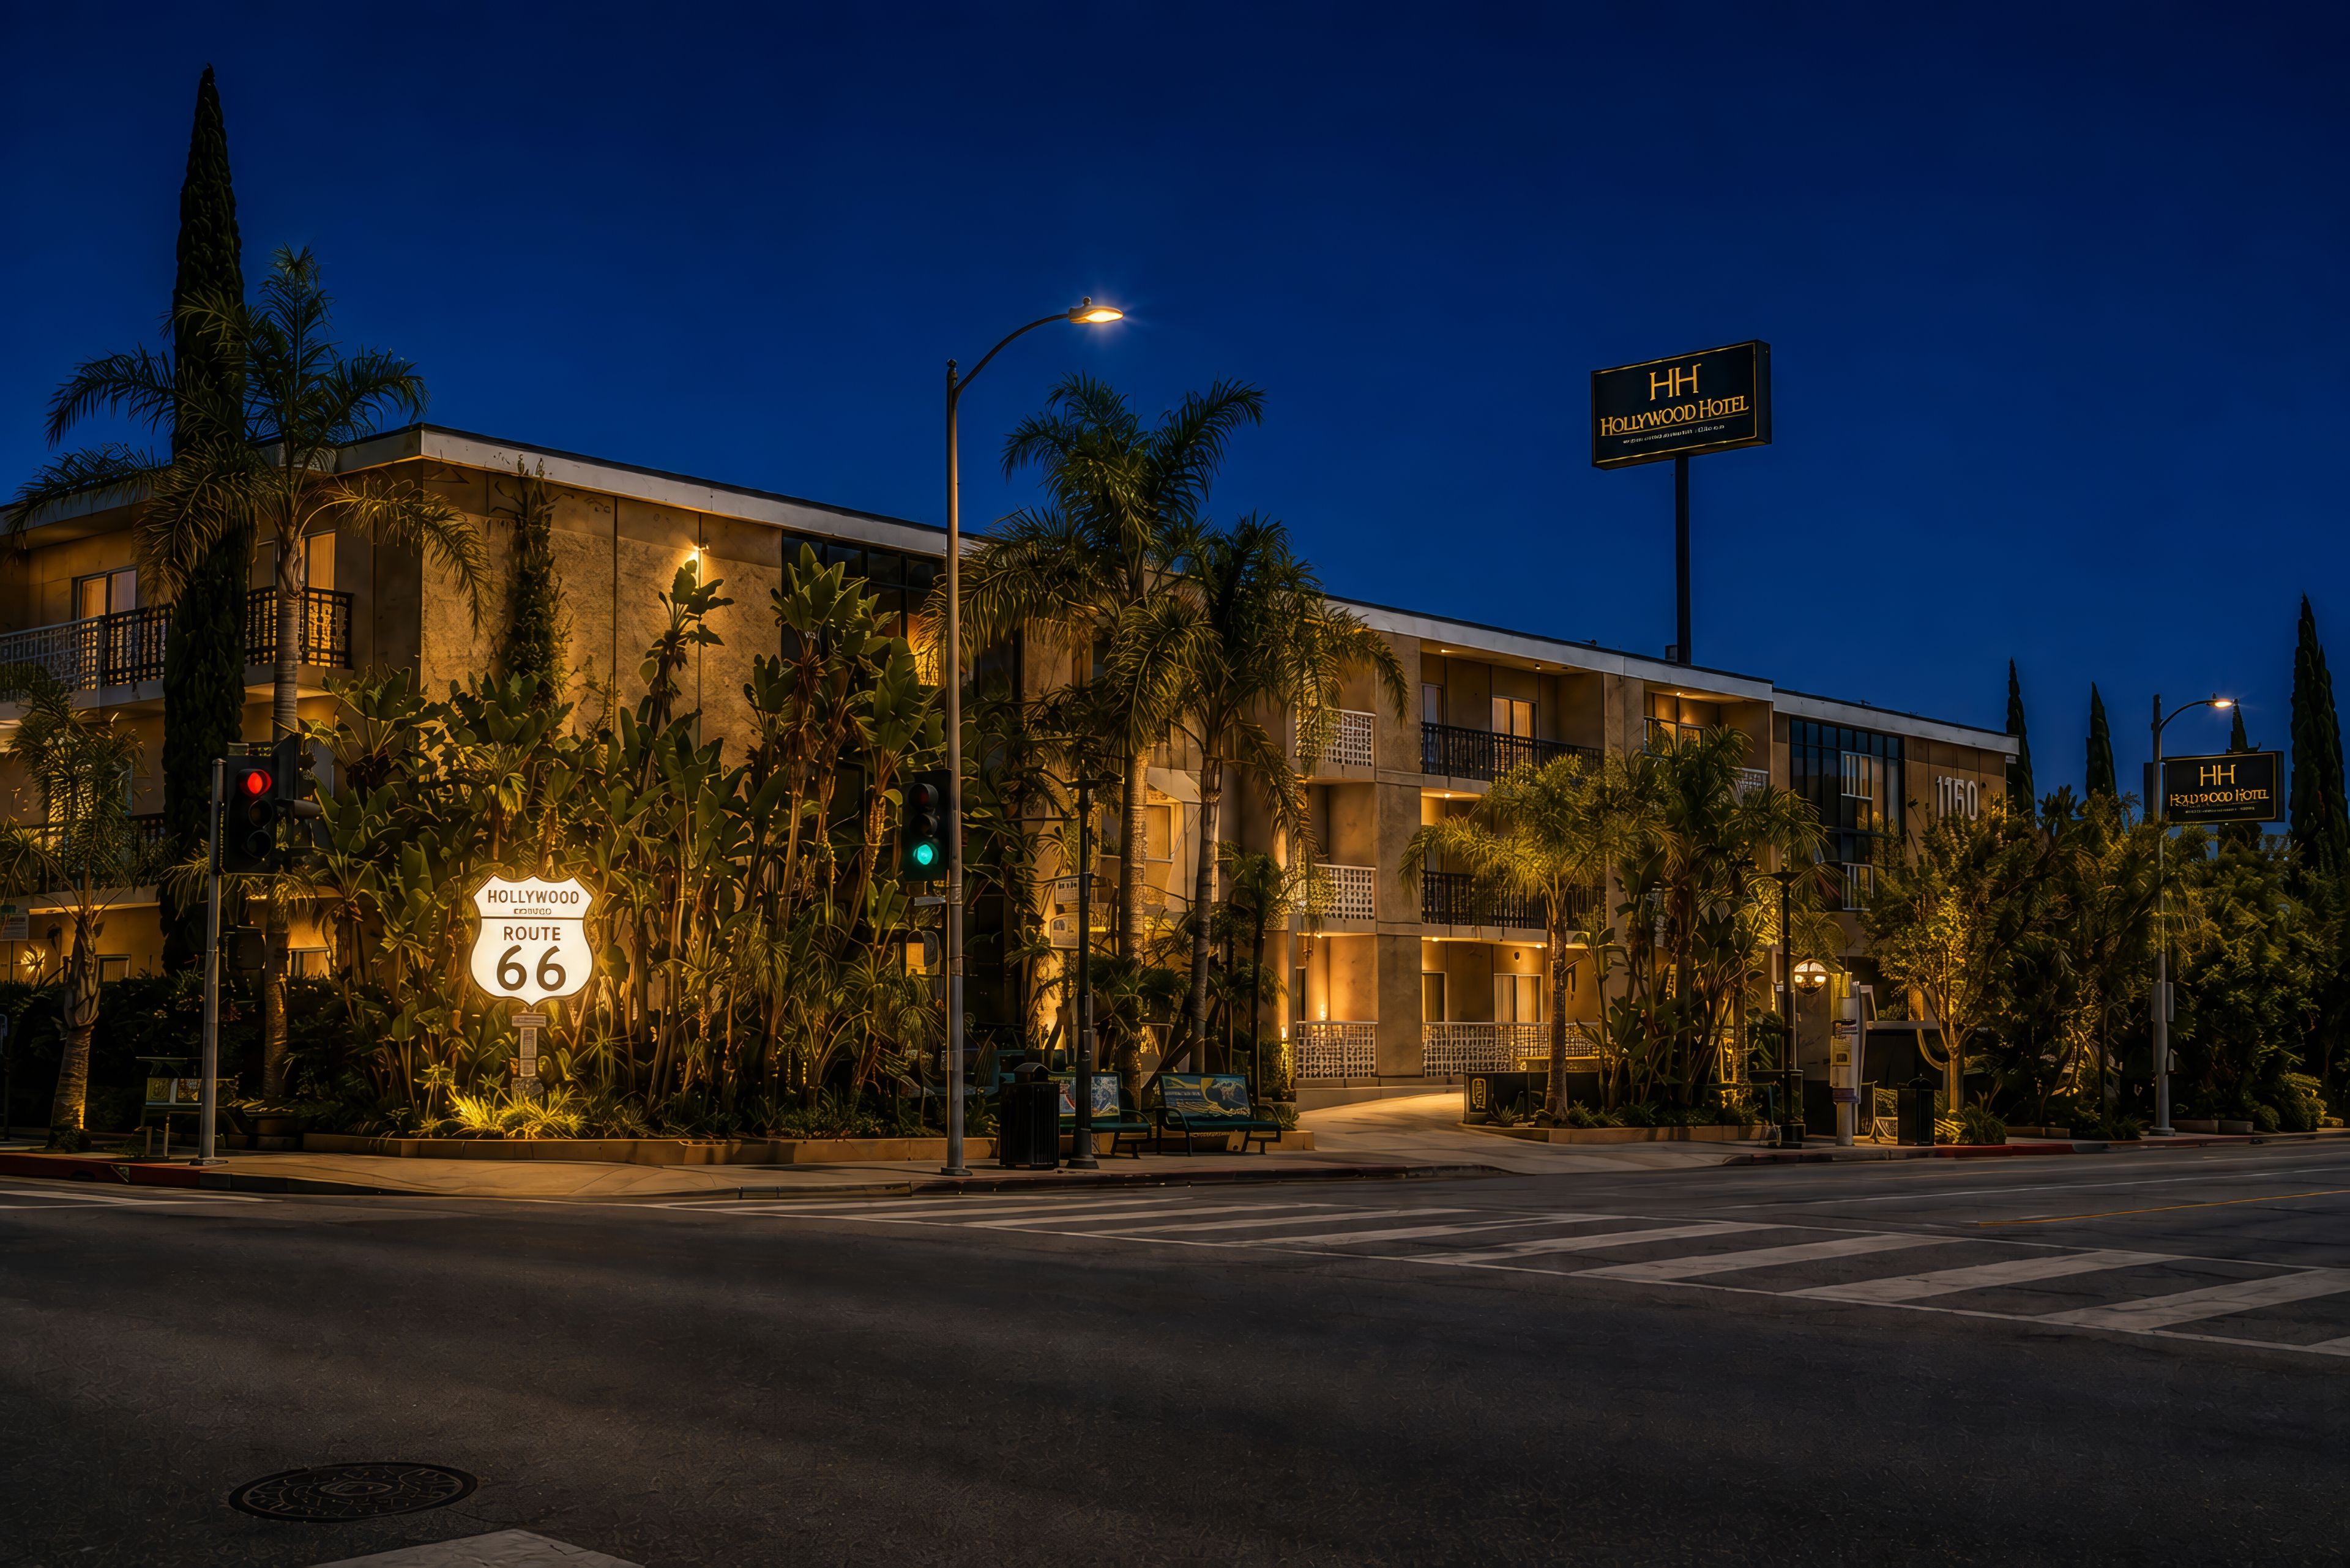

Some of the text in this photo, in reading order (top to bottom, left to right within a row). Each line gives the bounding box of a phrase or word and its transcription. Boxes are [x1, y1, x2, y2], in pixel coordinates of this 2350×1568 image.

[1649, 363, 1701, 401] HH
[1600, 404, 1696, 436] HOLLYWOOD
[1699, 395, 1749, 419] HOTEL
[2200, 764, 2236, 786] HH
[488, 890, 580, 904] HOLLYWOOD
[504, 926, 561, 941] ROUTE
[497, 944, 566, 991] 66
